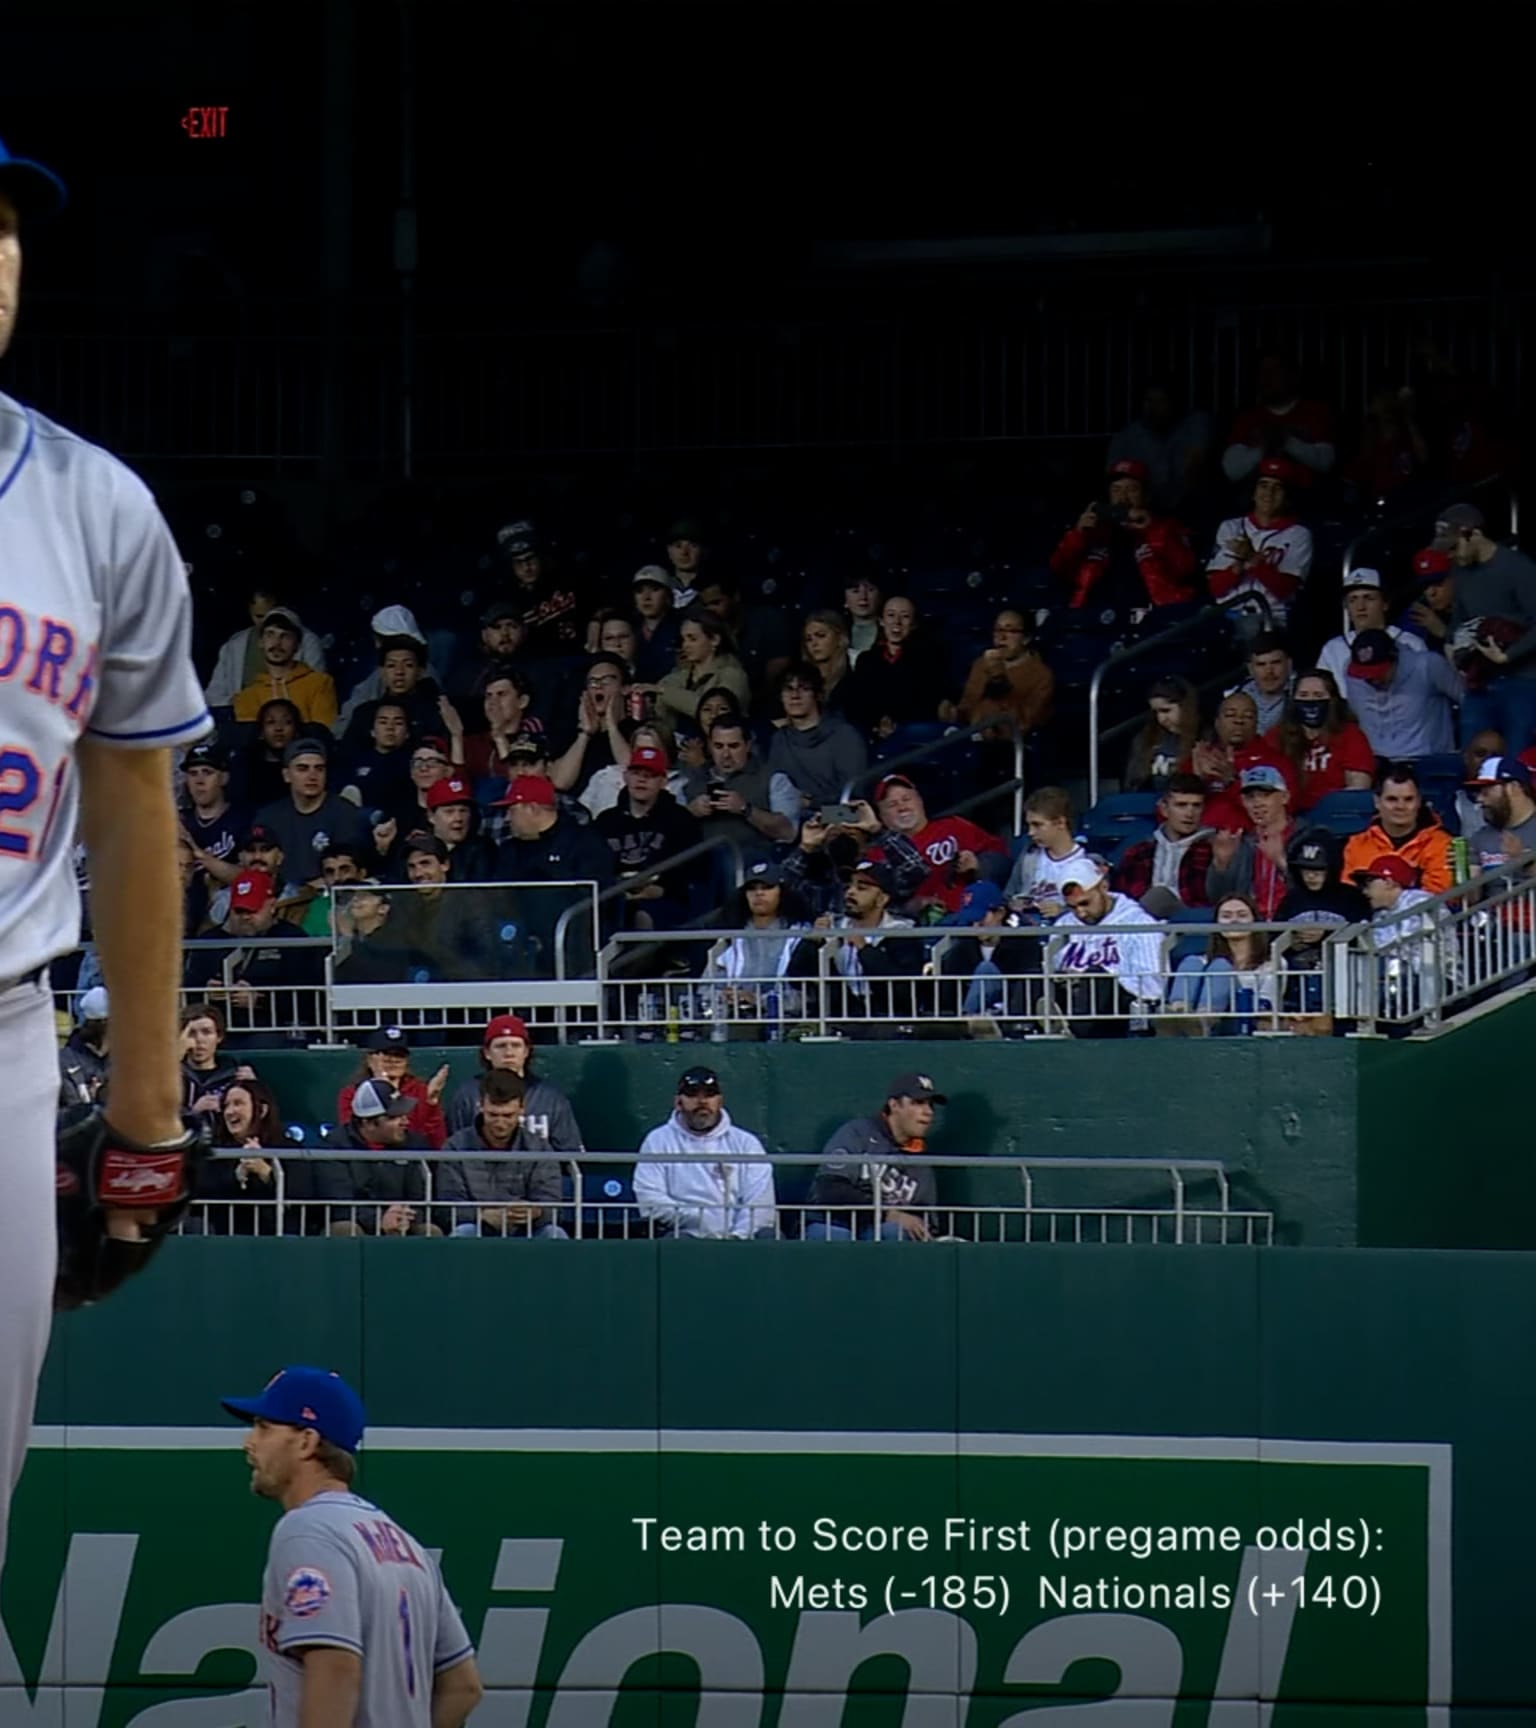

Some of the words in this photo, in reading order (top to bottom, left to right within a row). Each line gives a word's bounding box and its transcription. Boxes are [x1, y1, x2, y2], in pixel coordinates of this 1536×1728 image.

[189, 107, 229, 138] EXIT
[1062, 937, 1120, 970] Mets
[398, 1586, 418, 1699] 1
